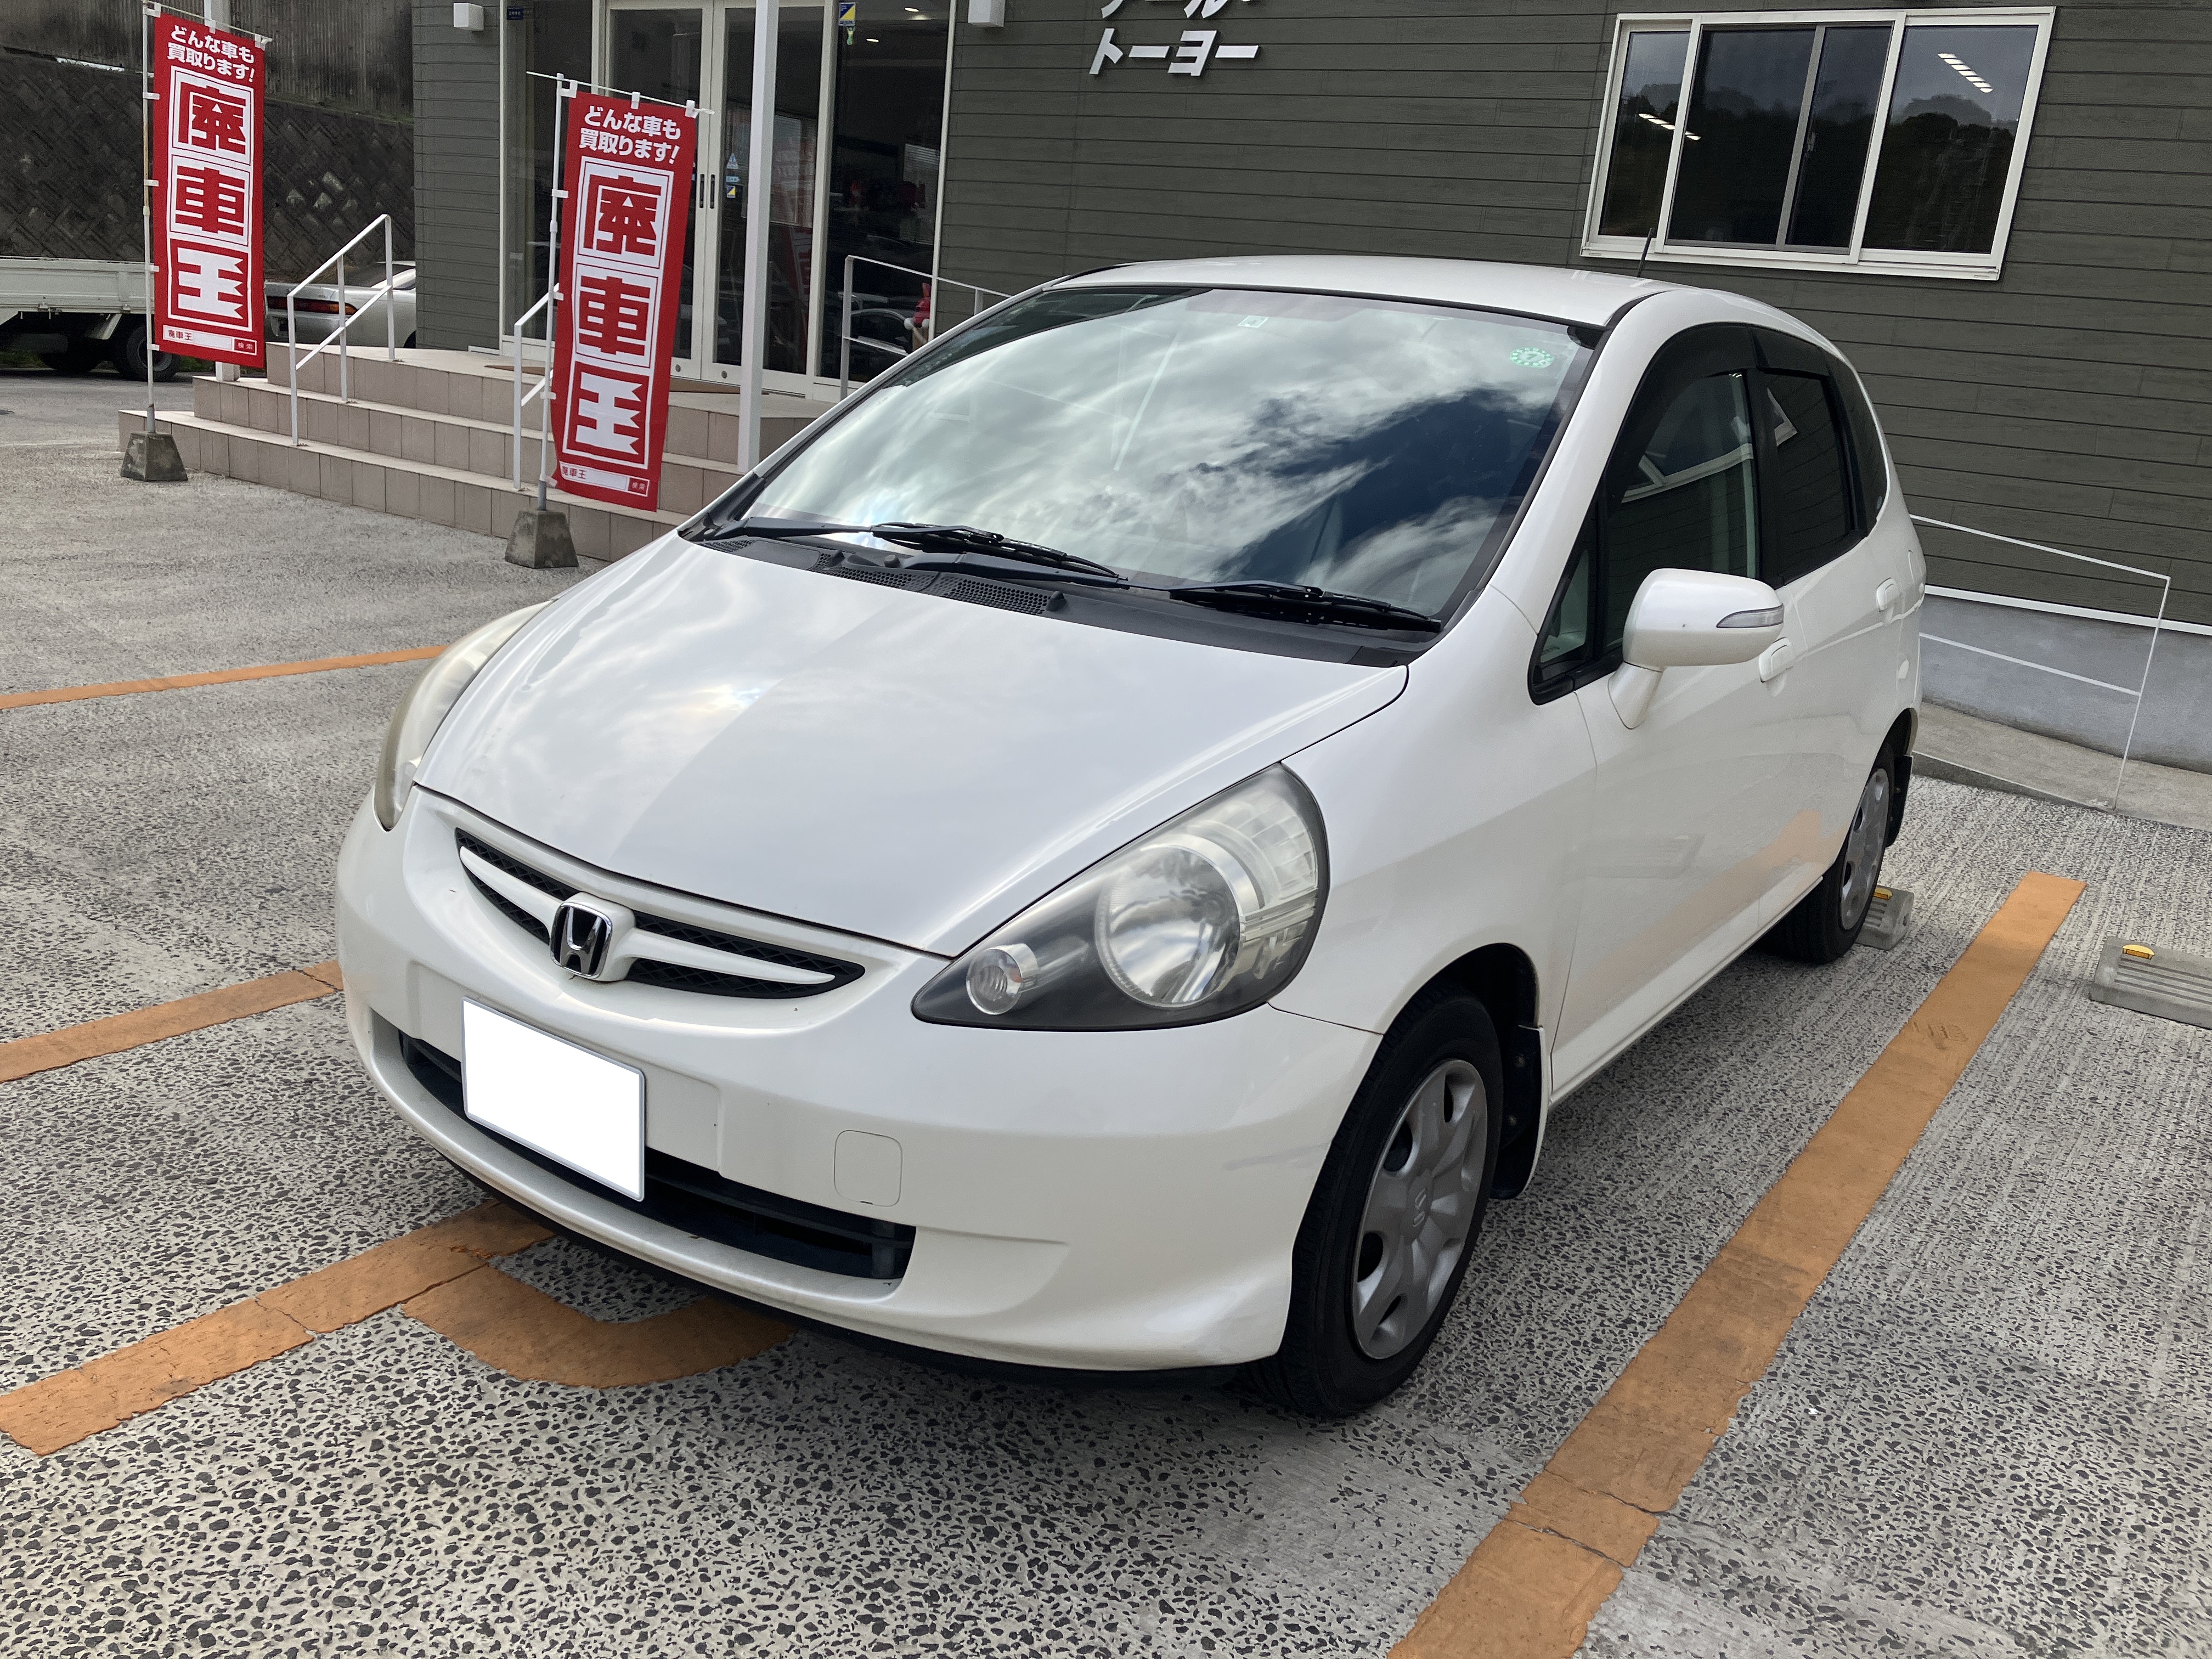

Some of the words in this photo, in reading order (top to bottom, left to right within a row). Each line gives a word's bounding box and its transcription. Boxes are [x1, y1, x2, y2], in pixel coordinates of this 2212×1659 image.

[171, 25, 255, 64] どんな車も
[1089, 27, 1260, 76] トーヨー
[584, 105, 681, 140] どんな車も
